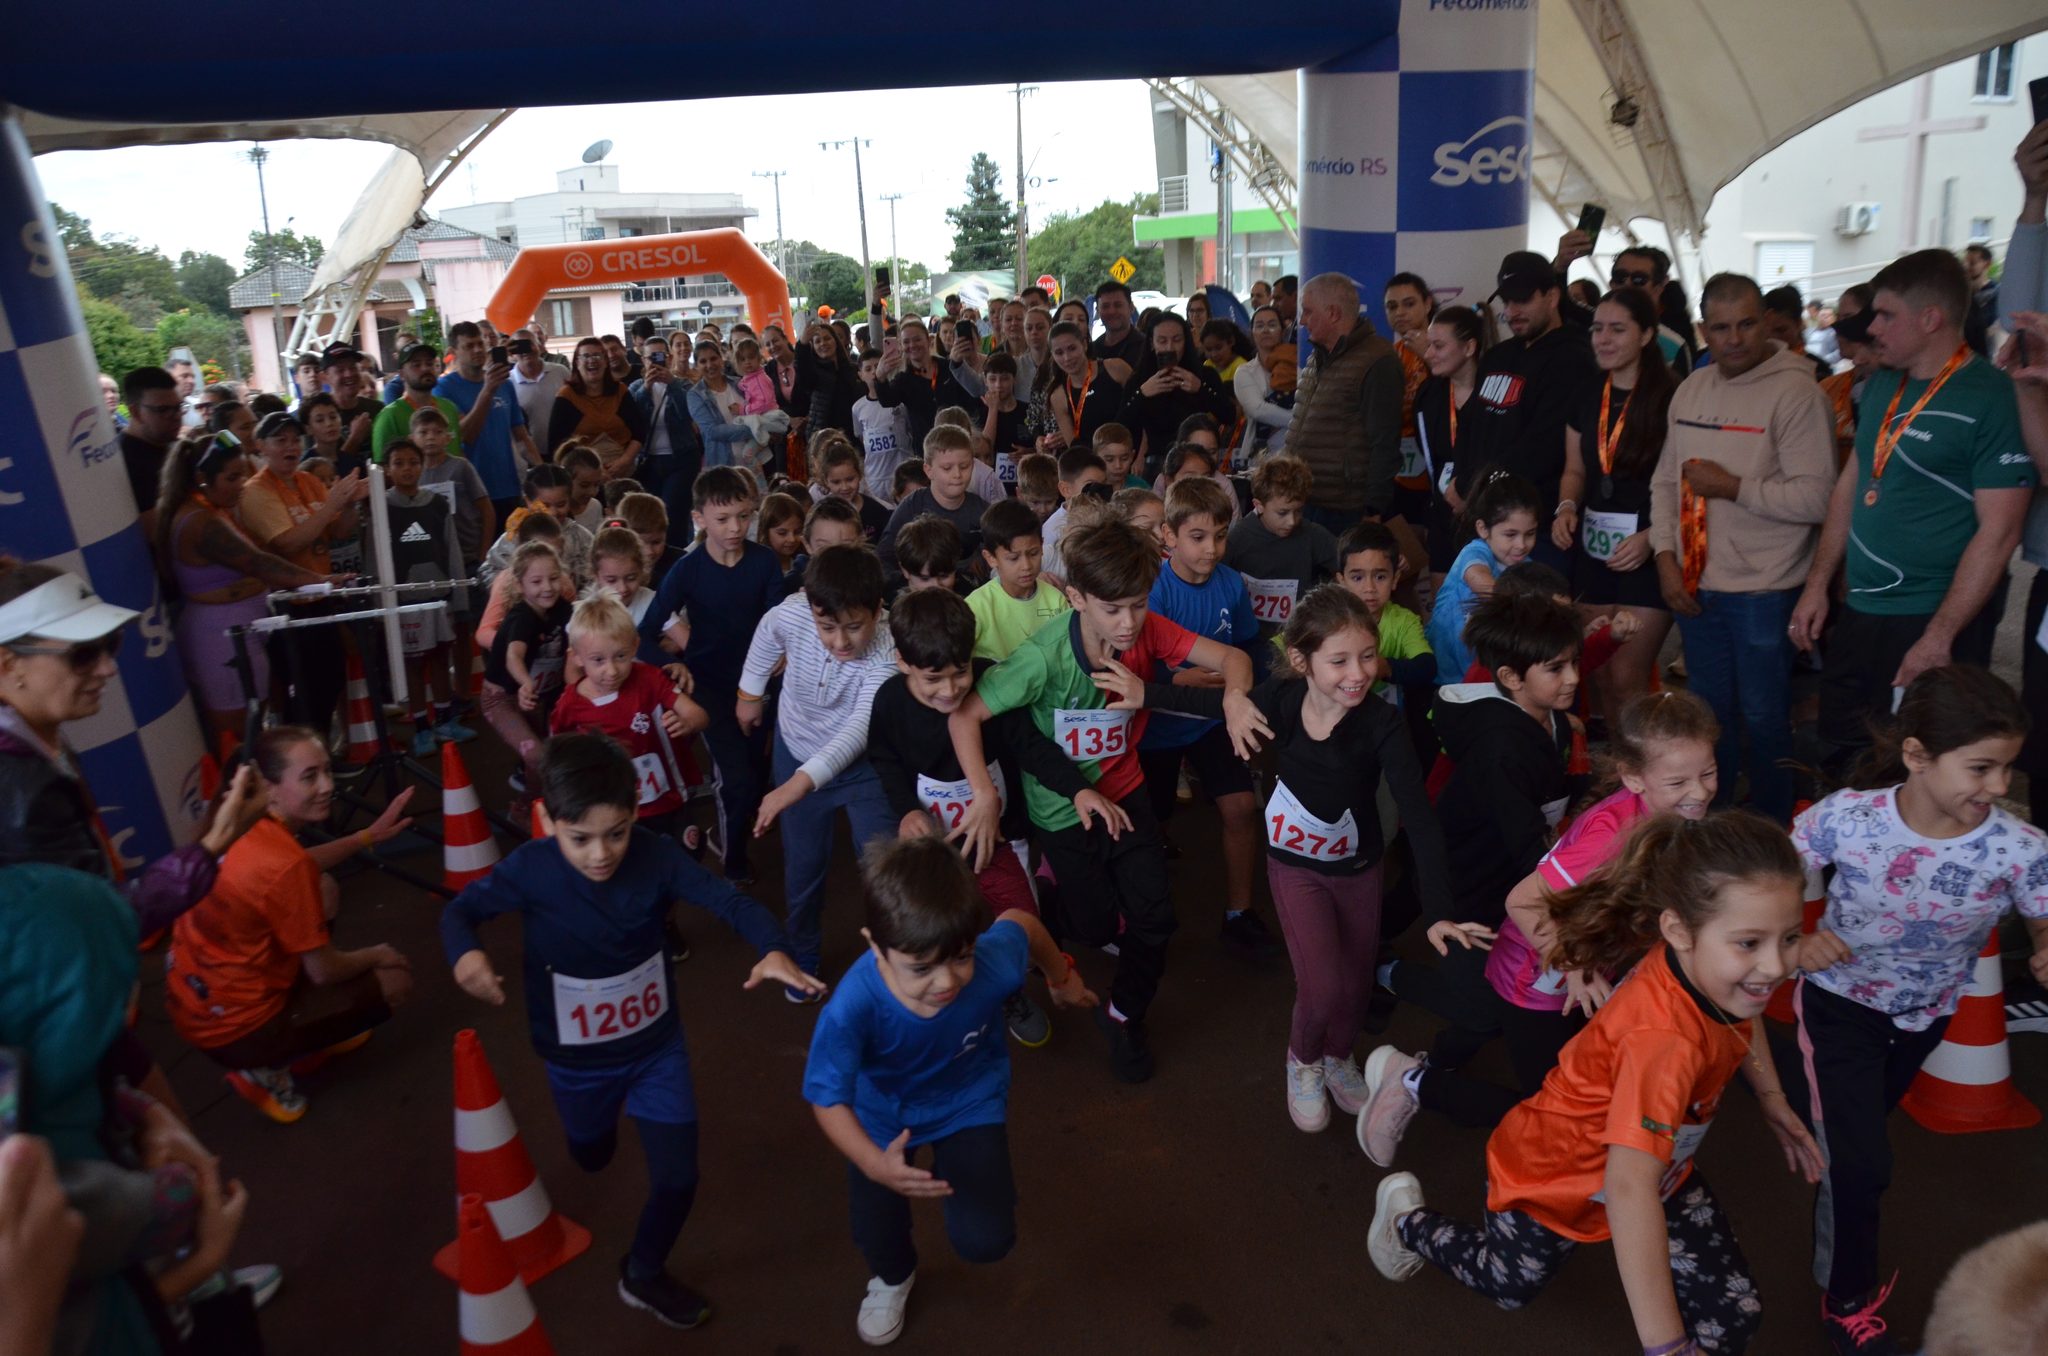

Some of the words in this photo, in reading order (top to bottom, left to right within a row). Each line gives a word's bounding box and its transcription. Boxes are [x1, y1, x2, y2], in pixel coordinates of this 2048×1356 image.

[1305, 155, 1354, 175] mércio
[1361, 157, 1387, 175] RS
[601, 244, 708, 273] CRESOL
[869, 434, 897, 452] 2582
[999, 464, 1017, 480] 25
[1249, 592, 1291, 619] 279
[929, 801, 974, 829] 12
[1272, 813, 1348, 856] 1274
[571, 982, 660, 1038] 1266
